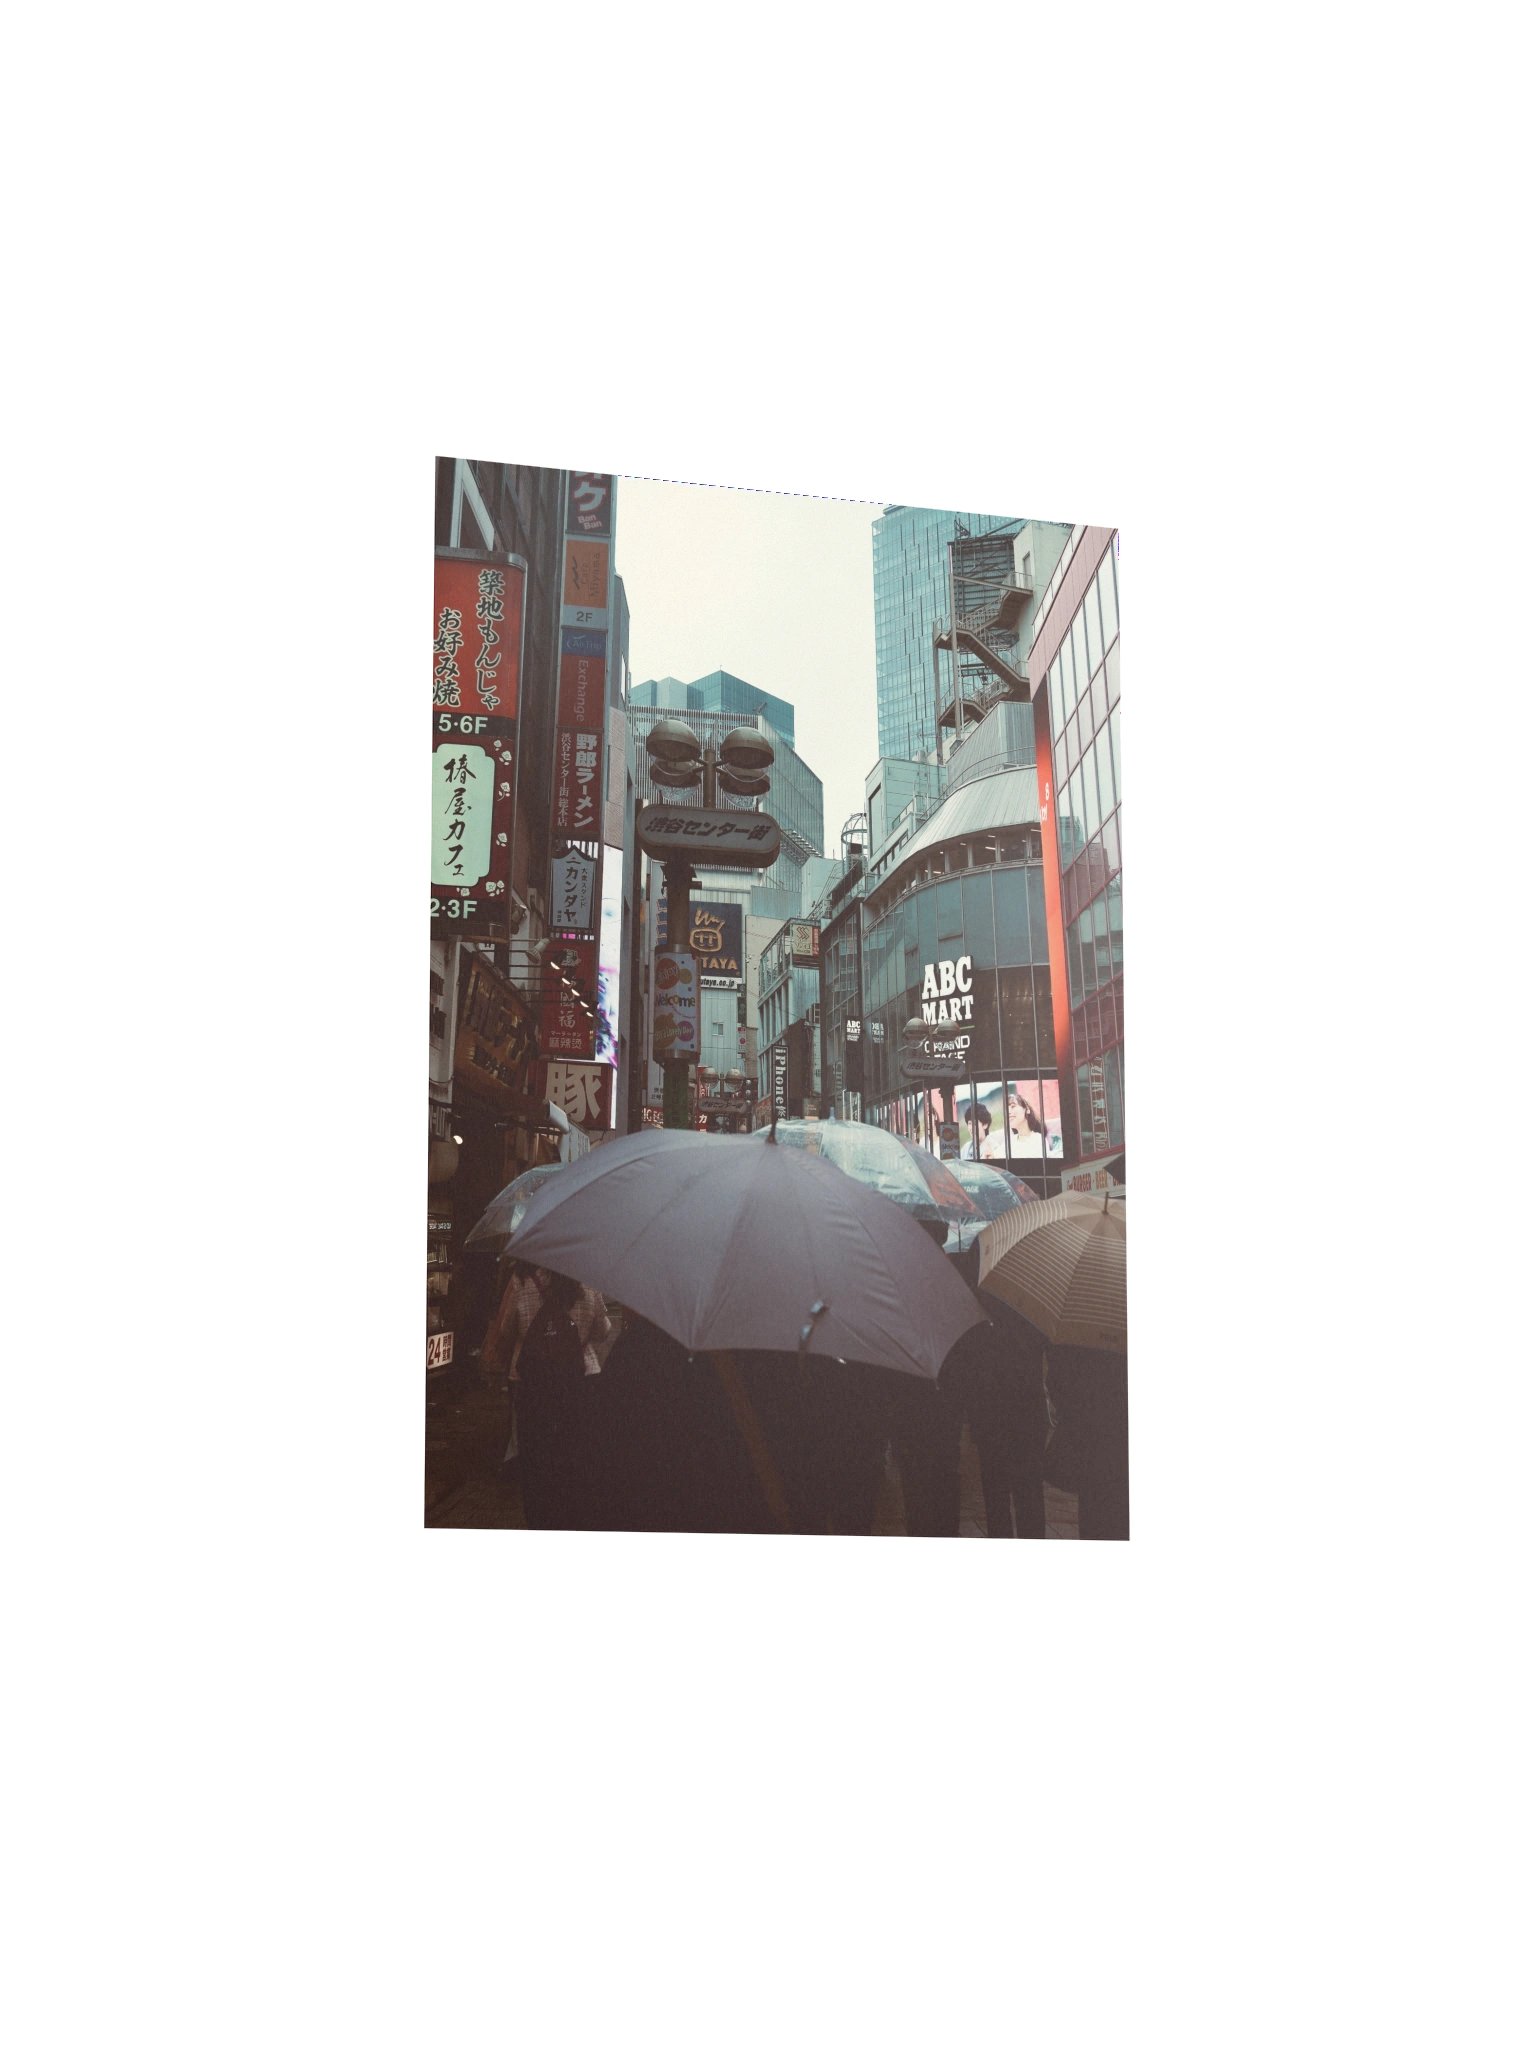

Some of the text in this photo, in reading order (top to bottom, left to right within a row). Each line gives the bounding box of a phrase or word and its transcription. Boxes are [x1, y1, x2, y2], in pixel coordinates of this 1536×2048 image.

[573, 471, 606, 511] ケ
[576, 611, 593, 622] 2F
[433, 607, 463, 708] お好み焼
[475, 569, 505, 710] 築地もんじゃ
[573, 659, 589, 722] Exchange
[573, 733, 597, 828] 野郎ラーメン
[443, 753, 477, 878] 椿屋カフェ
[645, 815, 771, 841] 渋谷センター街
[564, 866, 579, 923] カンダヤ
[701, 978, 735, 988] utaya.co.jp
[702, 956, 738, 970] TAYA
[921, 954, 973, 999] ABC
[846, 1019, 861, 1029] ABC
[922, 994, 974, 1025] MART
[545, 1064, 602, 1122] 豚
[428, 1337, 441, 1365] 24
